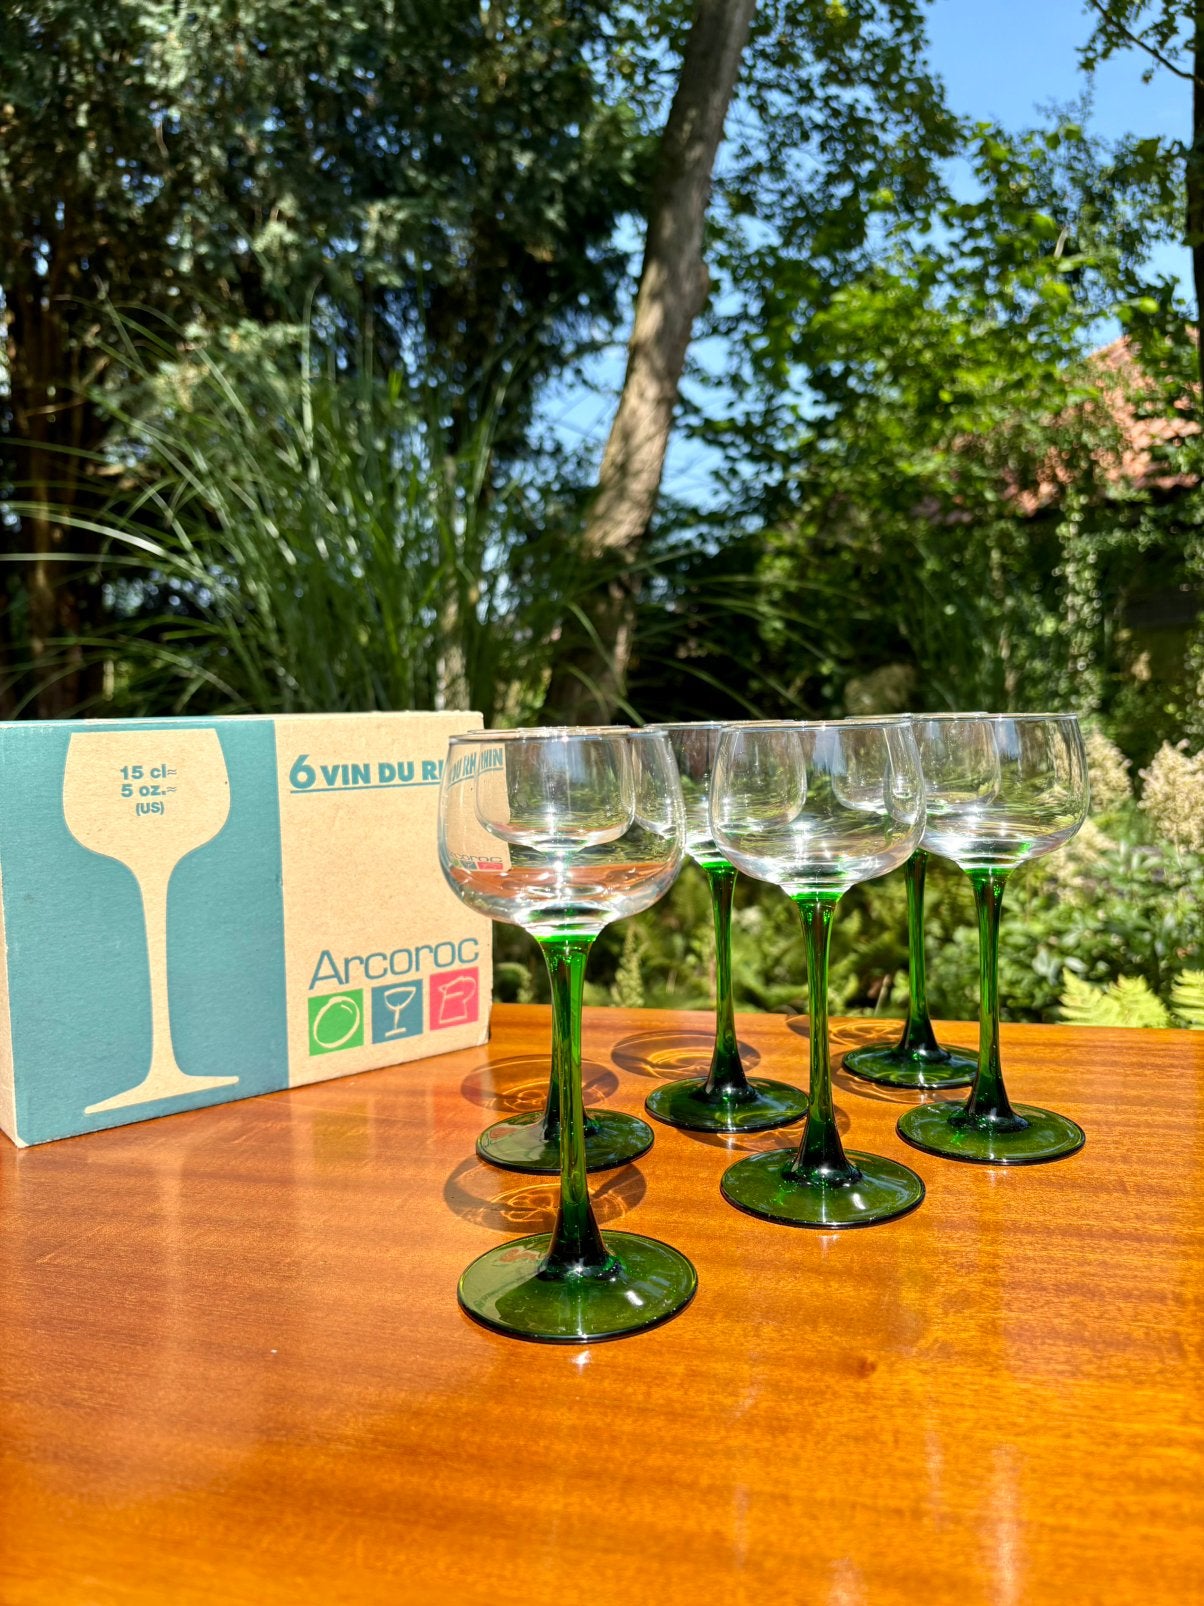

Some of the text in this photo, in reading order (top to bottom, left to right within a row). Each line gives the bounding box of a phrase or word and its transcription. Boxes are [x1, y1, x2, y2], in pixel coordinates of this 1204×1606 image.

[120, 765, 144, 780] 15
[289, 754, 317, 789] 6
[320, 763, 371, 786] VIN
[378, 761, 414, 783] DU
[121, 784, 133, 797] 5
[136, 801, 165, 816] (US)
[308, 937, 479, 990] Arcoroc
